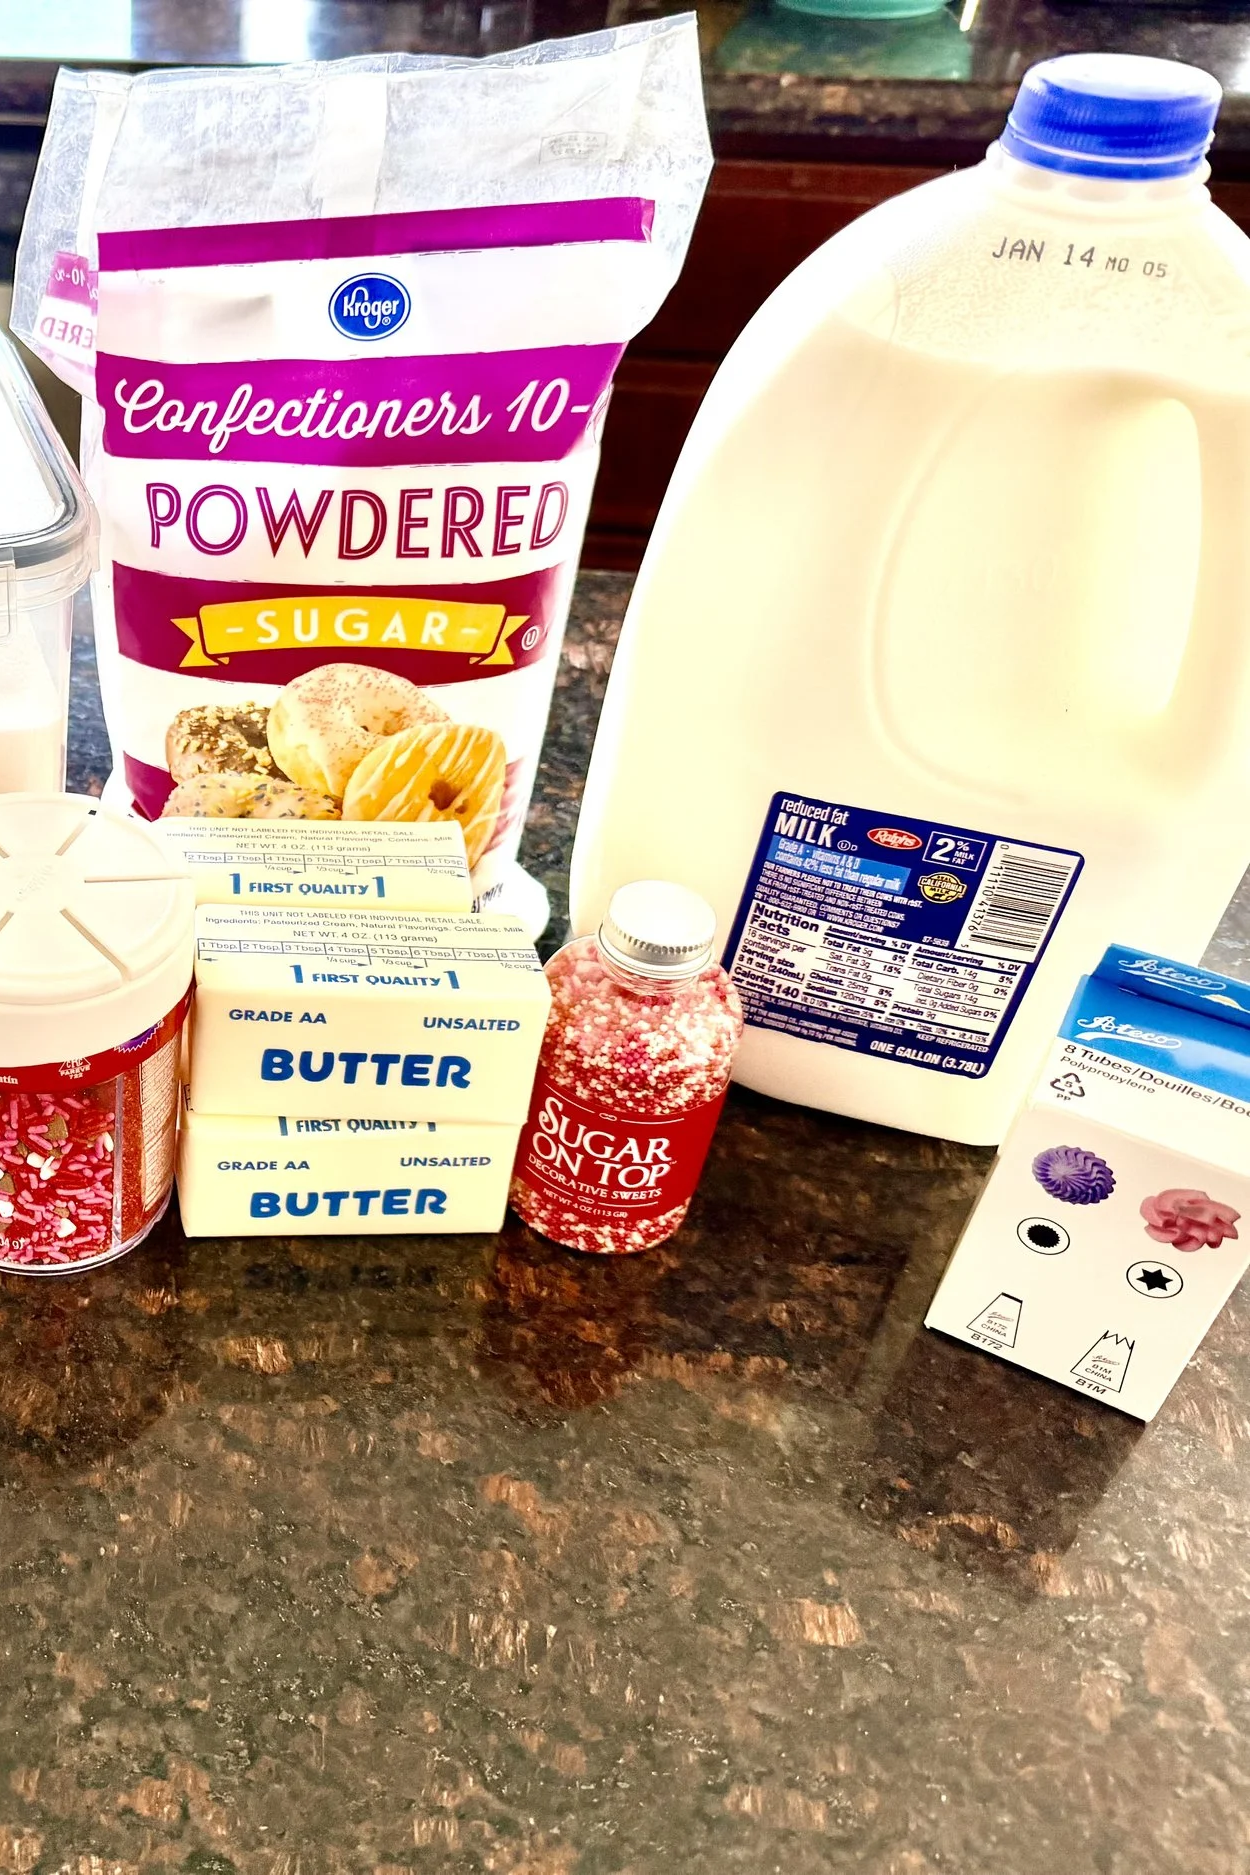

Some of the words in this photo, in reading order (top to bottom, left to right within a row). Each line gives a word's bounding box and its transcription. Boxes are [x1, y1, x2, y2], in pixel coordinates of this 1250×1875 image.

[993, 236, 1045, 262] JAN
[1063, 243, 1096, 268] 14
[342, 286, 400, 329] Kroger
[114, 379, 492, 454] Confectioners
[145, 481, 569, 561] POWDERED
[780, 798, 831, 821] reduced
[830, 807, 850, 826] fat
[773, 811, 838, 848] MILK
[871, 829, 918, 848] Ralphs
[930, 836, 971, 863] 2%
[953, 849, 975, 862] MILK
[951, 856, 967, 866] FAT
[248, 881, 294, 894] FIRST
[298, 883, 370, 896] QUALITY
[920, 878, 964, 894] CALIFORNIA
[262, 910, 284, 918] UNIT
[306, 912, 348, 920] LABELED
[348, 913, 368, 921] FOR
[369, 914, 423, 924] INDIVIDUAL
[750, 915, 791, 937] Facts
[753, 903, 820, 933] Nutrition
[292, 929, 317, 938] NET
[373, 933, 399, 942] (113
[400, 934, 439, 944] grams)
[743, 937, 782, 955] container
[758, 931, 792, 951] servings
[826, 924, 888, 947] Amount/serving
[740, 944, 776, 965] Serving
[777, 957, 796, 969] size
[822, 936, 846, 951] Total
[846, 942, 862, 954] Fat
[862, 946, 874, 958] 5g
[916, 946, 985, 967] Amount/serving
[767, 964, 807, 983] (240mL)
[846, 955, 861, 966] Fat
[882, 963, 903, 976] 15%
[911, 957, 935, 970] Total
[935, 963, 960, 976] Carb.
[962, 968, 979, 980] 14g
[1117, 959, 1220, 989] Ateco
[311, 972, 360, 984] FIRST
[365, 974, 442, 987] QUALITY
[733, 965, 777, 988] Calories
[775, 981, 801, 1000] 140
[809, 971, 846, 987] Cholest.
[846, 981, 870, 994] 25mg
[916, 971, 946, 986] Dietary
[946, 978, 968, 990] Fiber
[804, 982, 838, 997] Sodium
[839, 990, 867, 1005] 120mg
[913, 983, 933, 995] Total
[933, 988, 962, 1001] Sugars
[963, 993, 980, 1005] 14g
[228, 1008, 294, 1023] GRADE
[298, 1010, 328, 1025] AA
[422, 1015, 522, 1033] UNSALTED
[890, 1003, 925, 1017] Protein
[1077, 1014, 1176, 1047] Ateco
[869, 1039, 896, 1055] ONE
[894, 1045, 943, 1066] GALLON
[941, 1055, 986, 1076] (3.78L)
[1063, 1043, 1077, 1055] 8
[259, 1047, 472, 1090] BUTTER
[1059, 1054, 1157, 1095] Polypropylene
[295, 1118, 342, 1133] FIRST
[537, 1096, 673, 1164] SUGAR
[216, 1159, 279, 1172] GRADE
[283, 1159, 312, 1171] AA
[399, 1155, 493, 1168] UNSALTED
[531, 1130, 586, 1178] ON
[593, 1159, 673, 1189] TOP
[527, 1152, 609, 1199] DECORATIVE
[610, 1187, 664, 1201] SWEETS
[249, 1187, 448, 1219] BUTTER
[542, 1186, 560, 1201] NET
[558, 1194, 574, 1208] WT
[578, 1203, 594, 1214] OZ
[980, 1322, 1008, 1338] CHINA
[970, 1332, 1004, 1351] B172
[1084, 1367, 1113, 1383] CHINA
[1074, 1378, 1108, 1396] B1M
